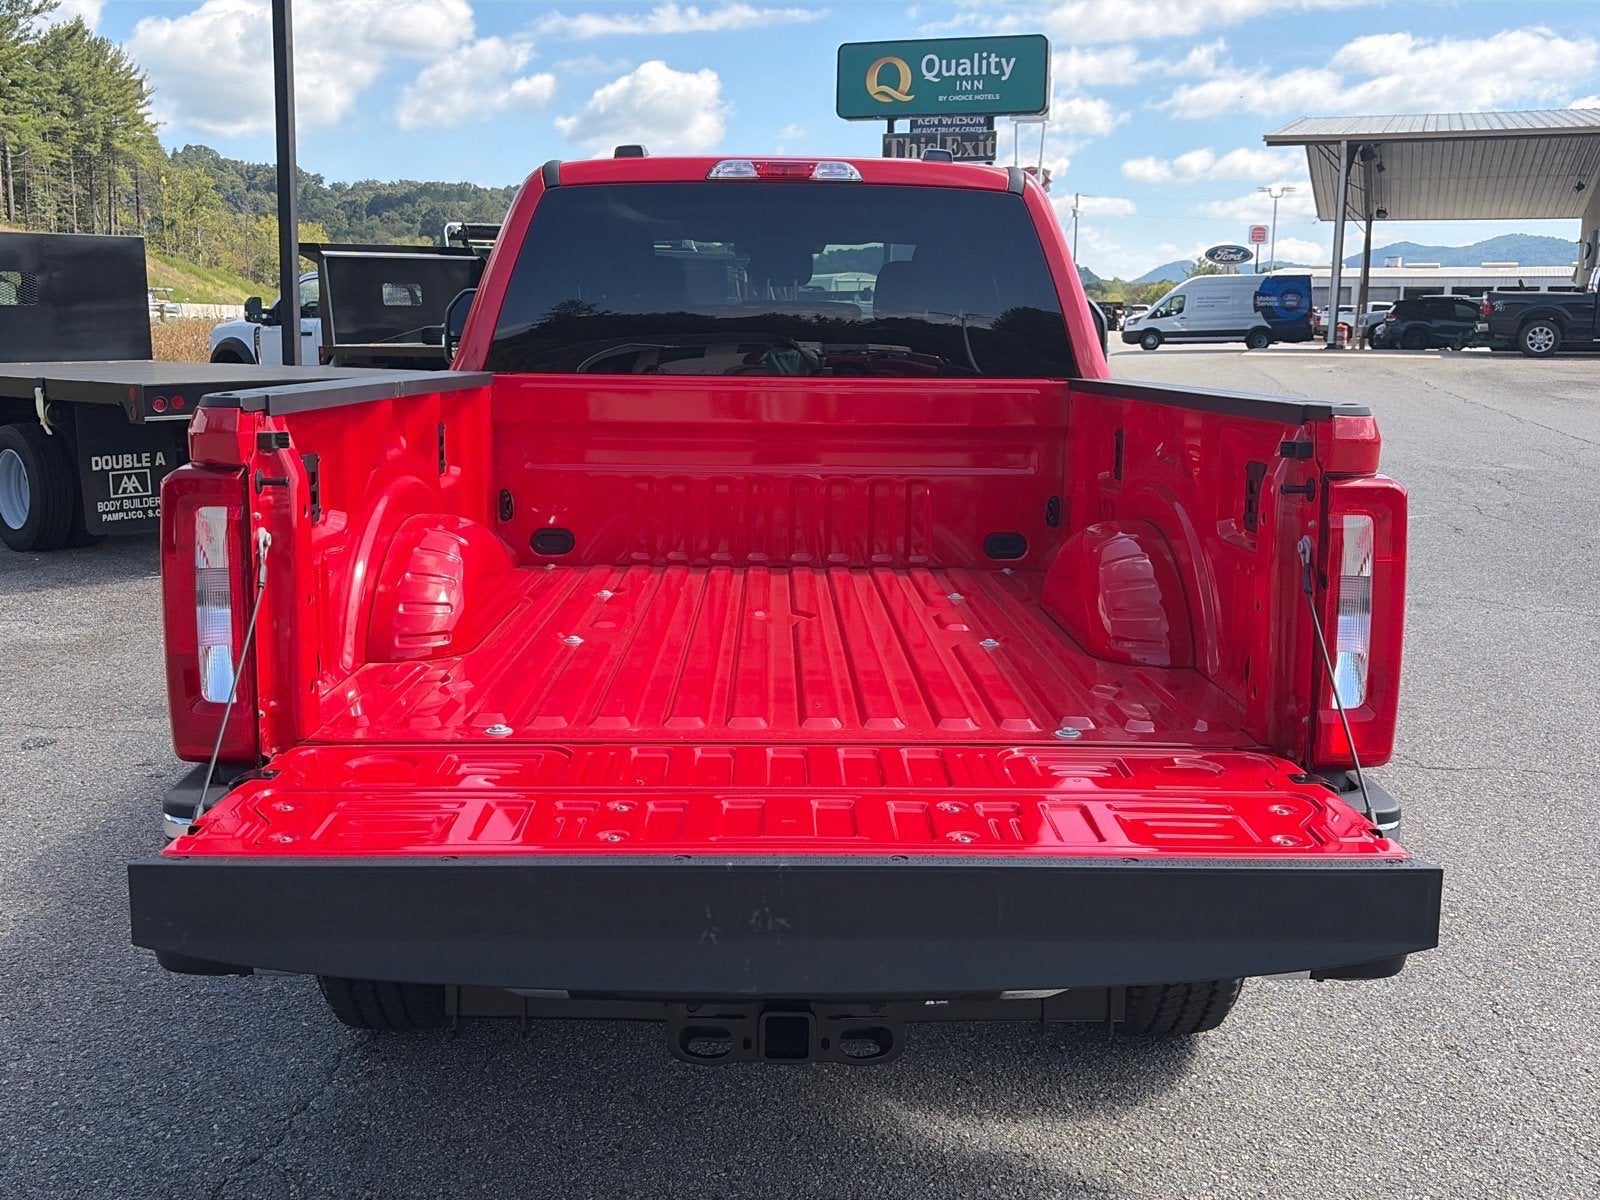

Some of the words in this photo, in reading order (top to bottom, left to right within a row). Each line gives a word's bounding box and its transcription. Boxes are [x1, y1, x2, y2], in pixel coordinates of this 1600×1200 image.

[921, 51, 1016, 82] Quality
[865, 56, 916, 103] Q
[956, 80, 983, 91] INN
[974, 93, 1000, 101] HOTELS
[917, 117, 938, 125] KEN
[940, 116, 985, 125] WILSON
[944, 134, 996, 158] Exit
[1214, 248, 1245, 261] Ford
[91, 452, 151, 471] DOUBLE
[155, 451, 166, 466] A
[97, 500, 121, 513] BODY
[102, 510, 146, 522] PAMPLICO,
